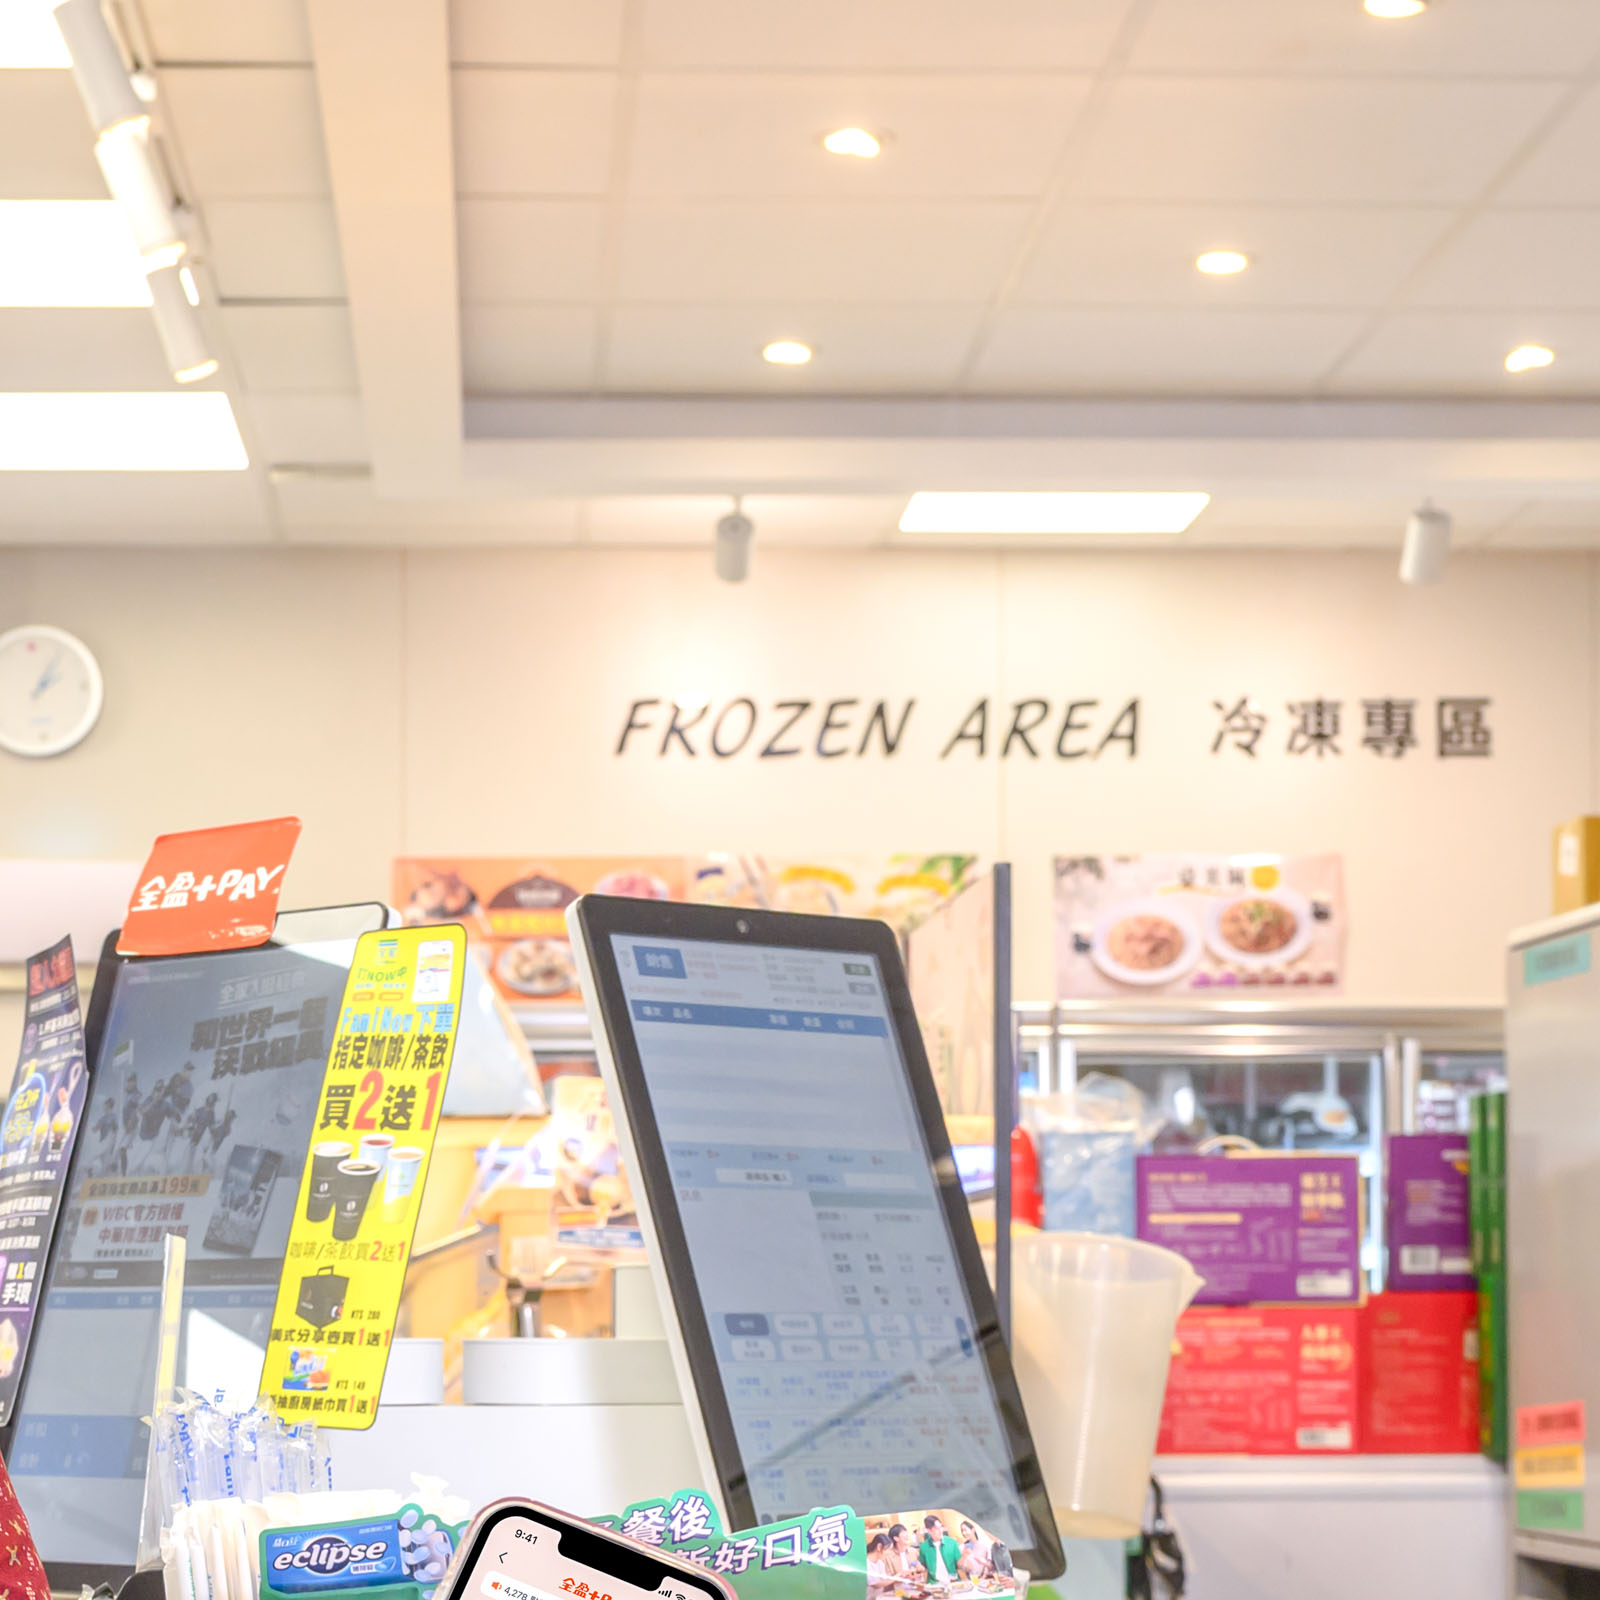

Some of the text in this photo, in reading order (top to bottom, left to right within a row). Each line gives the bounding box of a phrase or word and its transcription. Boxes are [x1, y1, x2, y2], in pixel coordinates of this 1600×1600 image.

[941, 697, 1144, 760] AREA
[1211, 697, 1494, 759] 冷凍專區
[332, 1034, 448, 1070] 指定咖啡/茶飲
[319, 1069, 442, 1131] 買2送1
[273, 1538, 388, 1572] eclipse
[514, 1529, 538, 1545] 9:41
